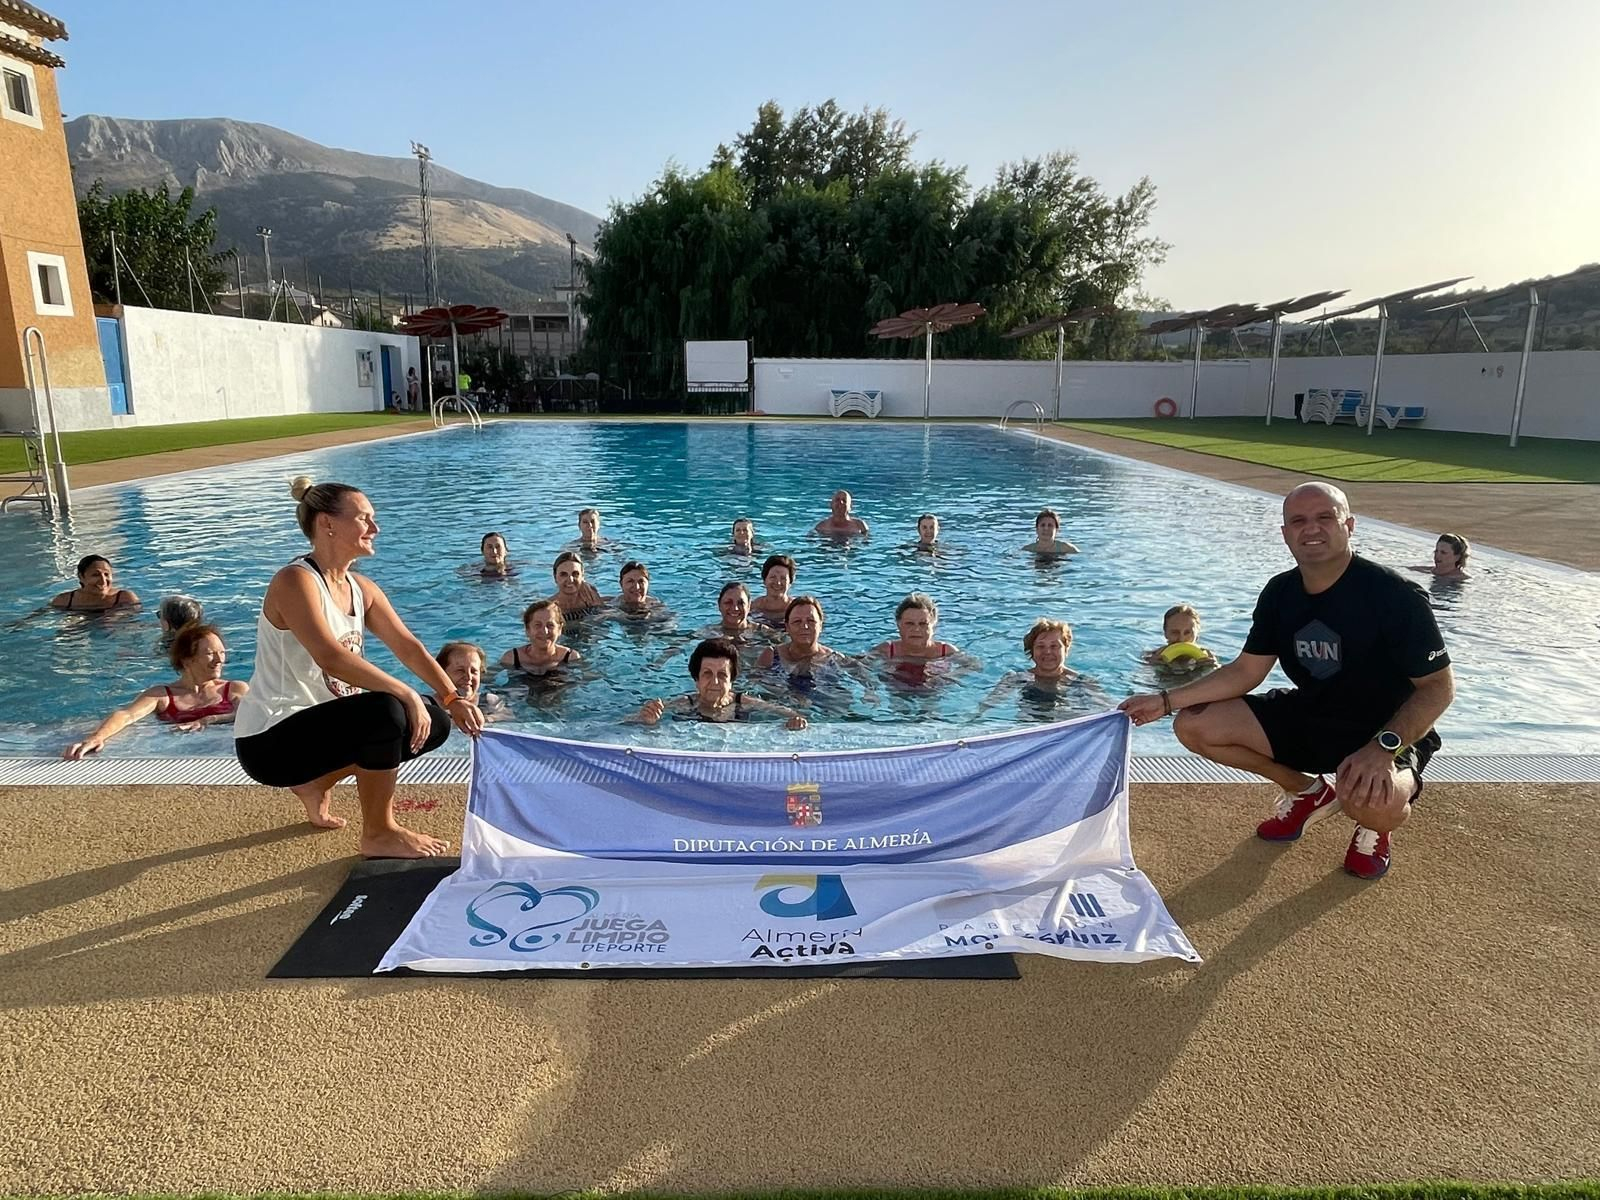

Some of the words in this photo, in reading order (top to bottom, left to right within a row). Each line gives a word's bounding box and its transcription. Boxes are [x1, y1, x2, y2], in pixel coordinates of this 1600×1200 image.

[1296, 640, 1338, 661] RUN
[673, 836, 805, 852] DIPUTACIÓN
[811, 839, 837, 851] DE
[843, 828, 932, 849] ALMERÍA
[572, 919, 667, 931] JUEGA
[566, 931, 670, 944] LIMPIO
[581, 943, 667, 952] DEPORTE
[750, 941, 855, 959] Activa
